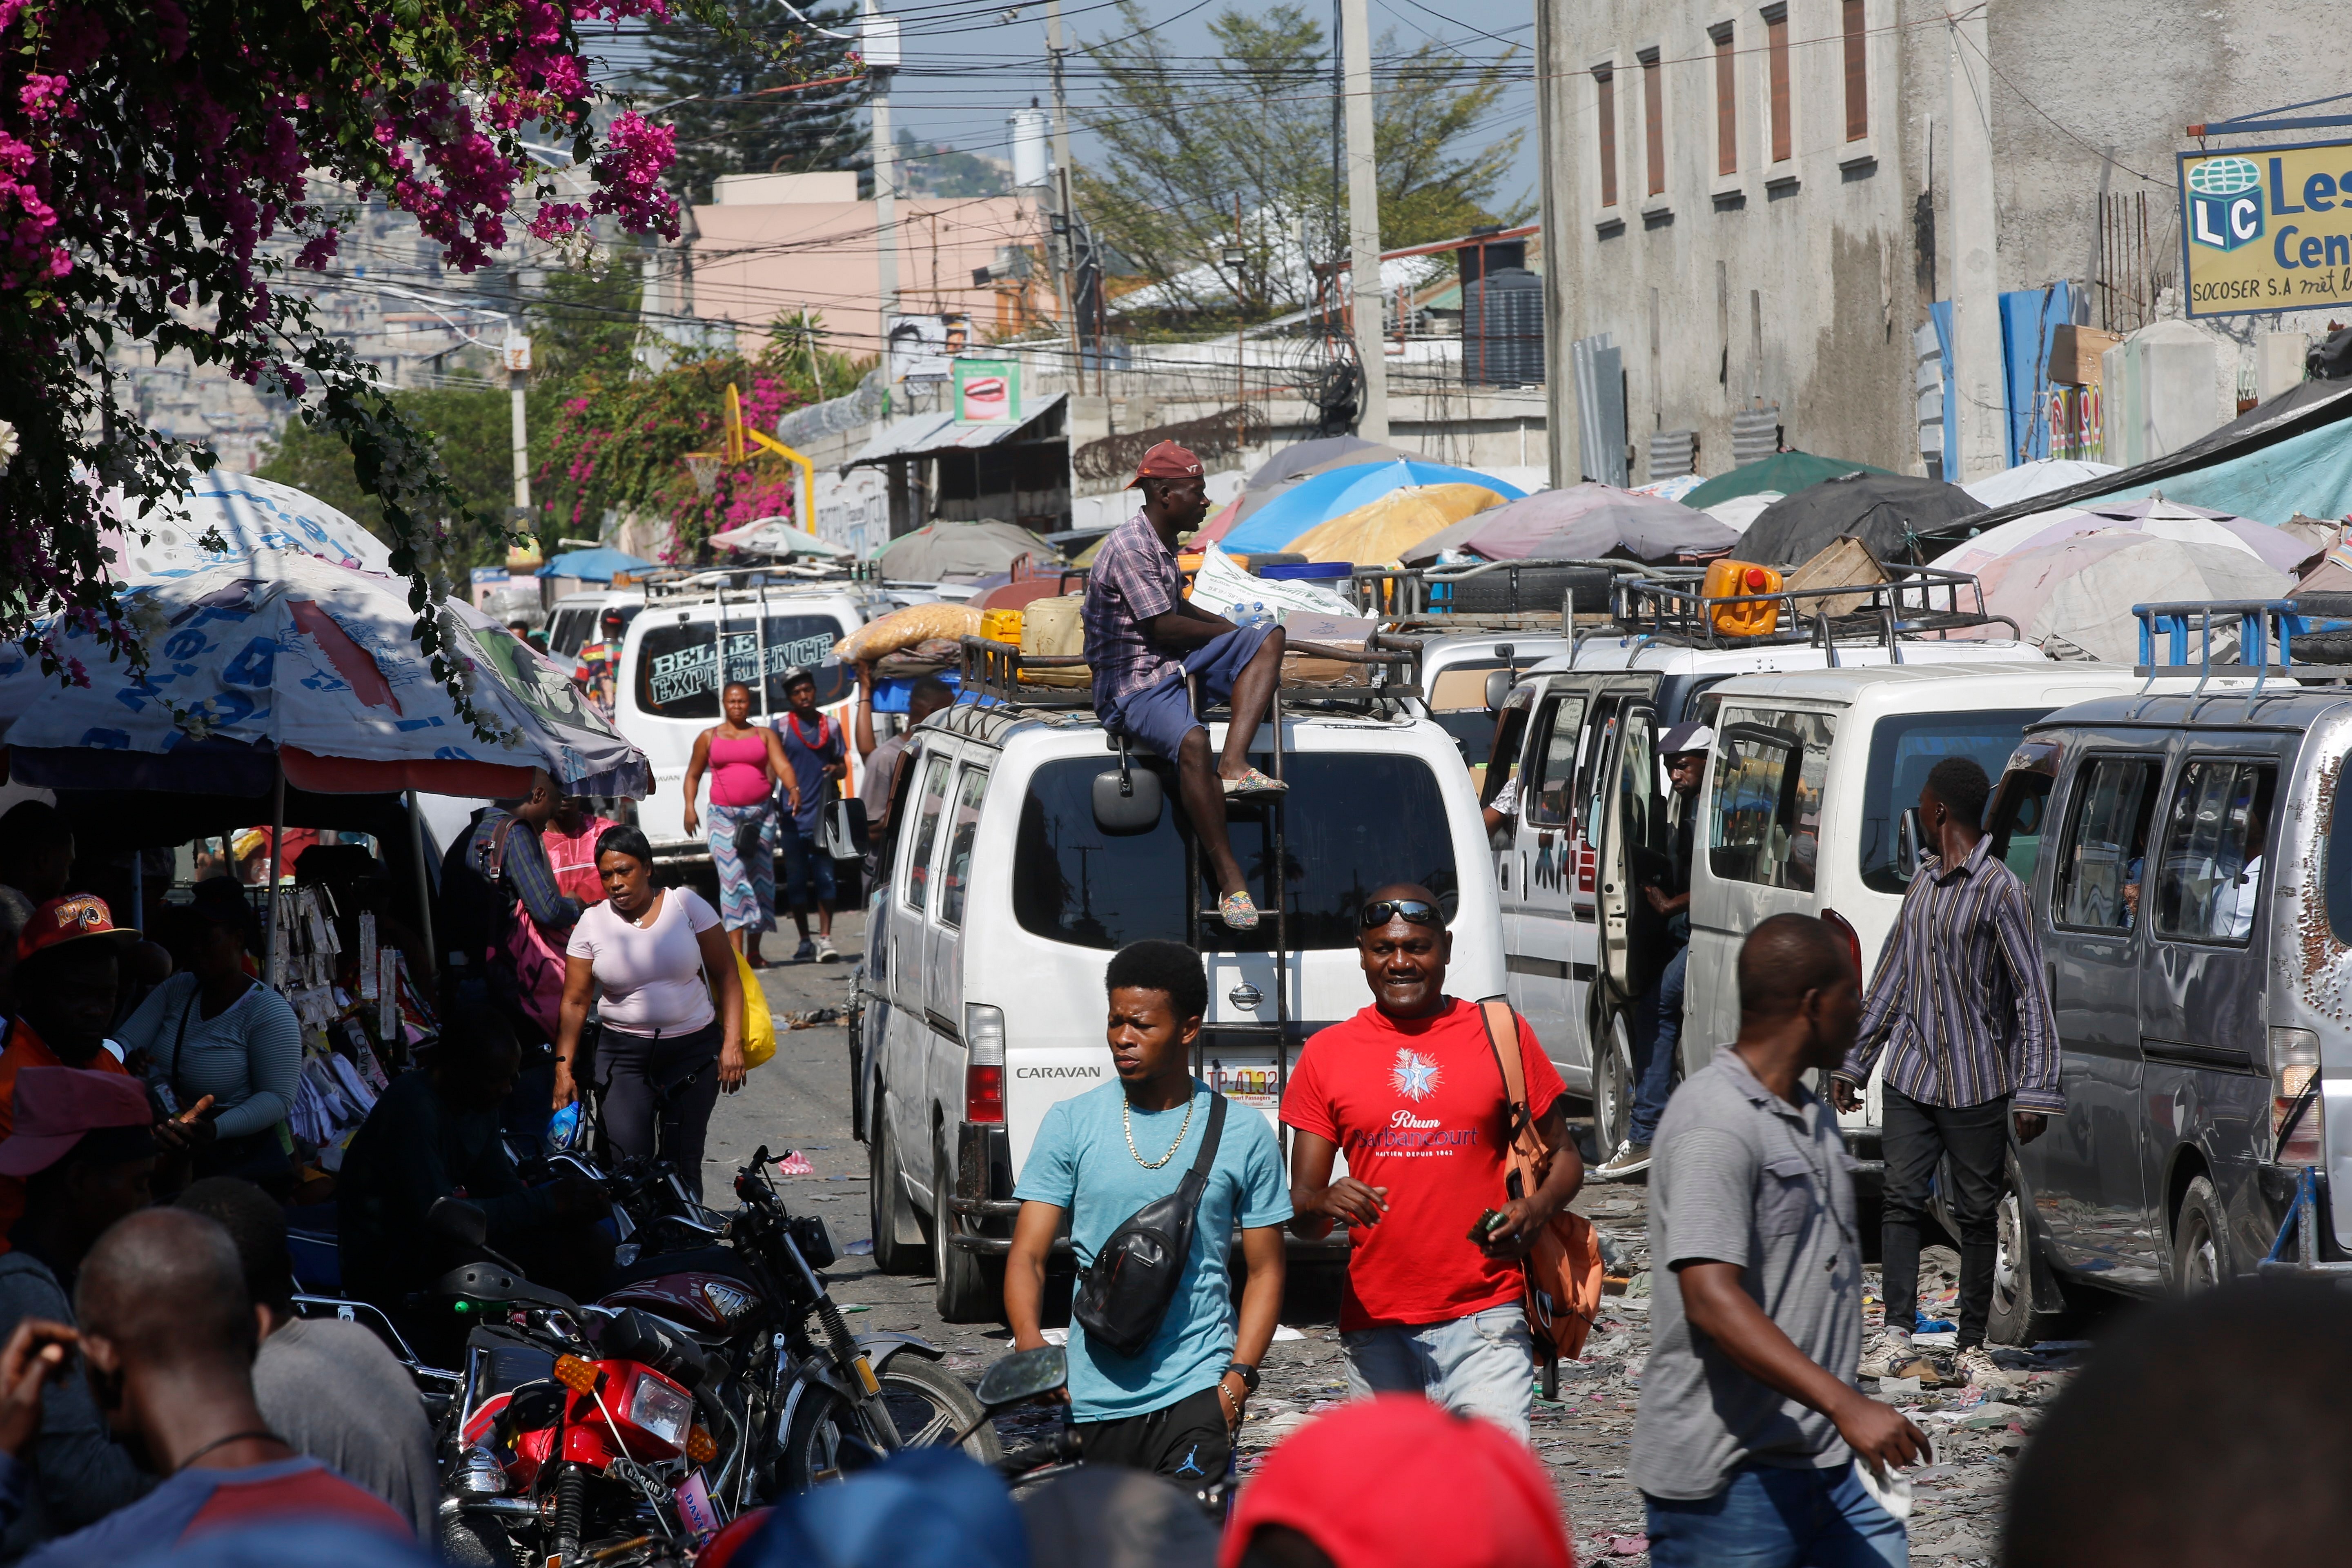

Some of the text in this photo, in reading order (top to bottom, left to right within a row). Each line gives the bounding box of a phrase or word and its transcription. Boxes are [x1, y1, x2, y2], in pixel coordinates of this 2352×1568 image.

[2274, 225, 2352, 269] Cen
[2193, 279, 2260, 301] SOCOSER
[1185, 464, 1198, 473] VT
[653, 634, 757, 677] BELLE
[650, 632, 834, 705] EXPERIENCE
[354, 1034, 371, 1076] Calvin
[372, 1070, 388, 1089] Kle
[1016, 1066, 1100, 1079] CARAVAN
[1390, 1109, 1441, 1129] Rhum
[1354, 1126, 1478, 1148] Barbancourt
